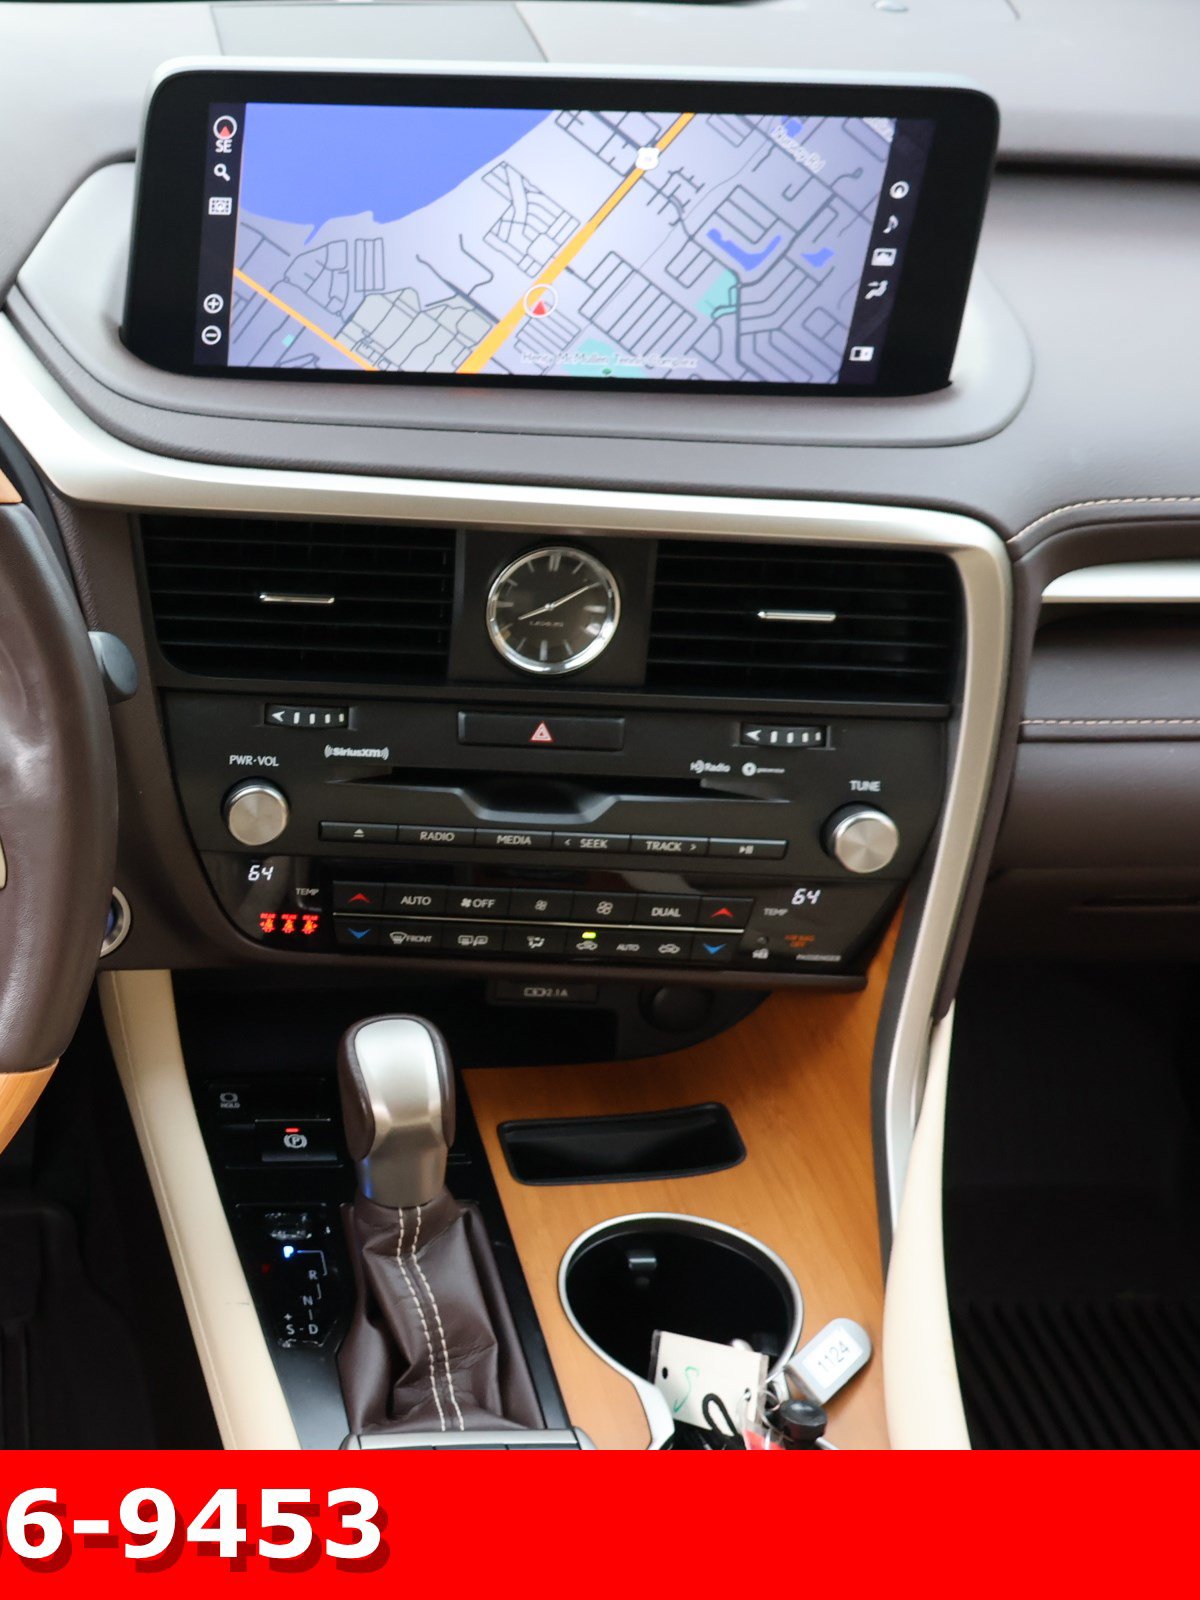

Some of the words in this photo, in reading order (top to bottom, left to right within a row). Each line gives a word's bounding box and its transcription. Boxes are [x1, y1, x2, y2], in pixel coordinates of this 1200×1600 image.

[214, 139, 232, 153] SE
[850, 780, 881, 792] TUNE
[420, 830, 455, 842] RADIO
[496, 835, 532, 846] MEDIA
[580, 838, 608, 849] SEEK
[646, 840, 682, 852] TRACK
[248, 864, 274, 881] 64
[296, 887, 320, 896] TEMP
[791, 888, 821, 905] 64
[401, 896, 432, 906] AUTO
[472, 898, 496, 909] OFF
[651, 906, 681, 917] DUAL
[406, 934, 432, 943] FRONT
[616, 943, 640, 952] AUTO
[308, 1269, 318, 1280] R
[303, 1295, 314, 1306] N
[286, 1324, 296, 1335] S
[308, 1323, 319, 1335] D
